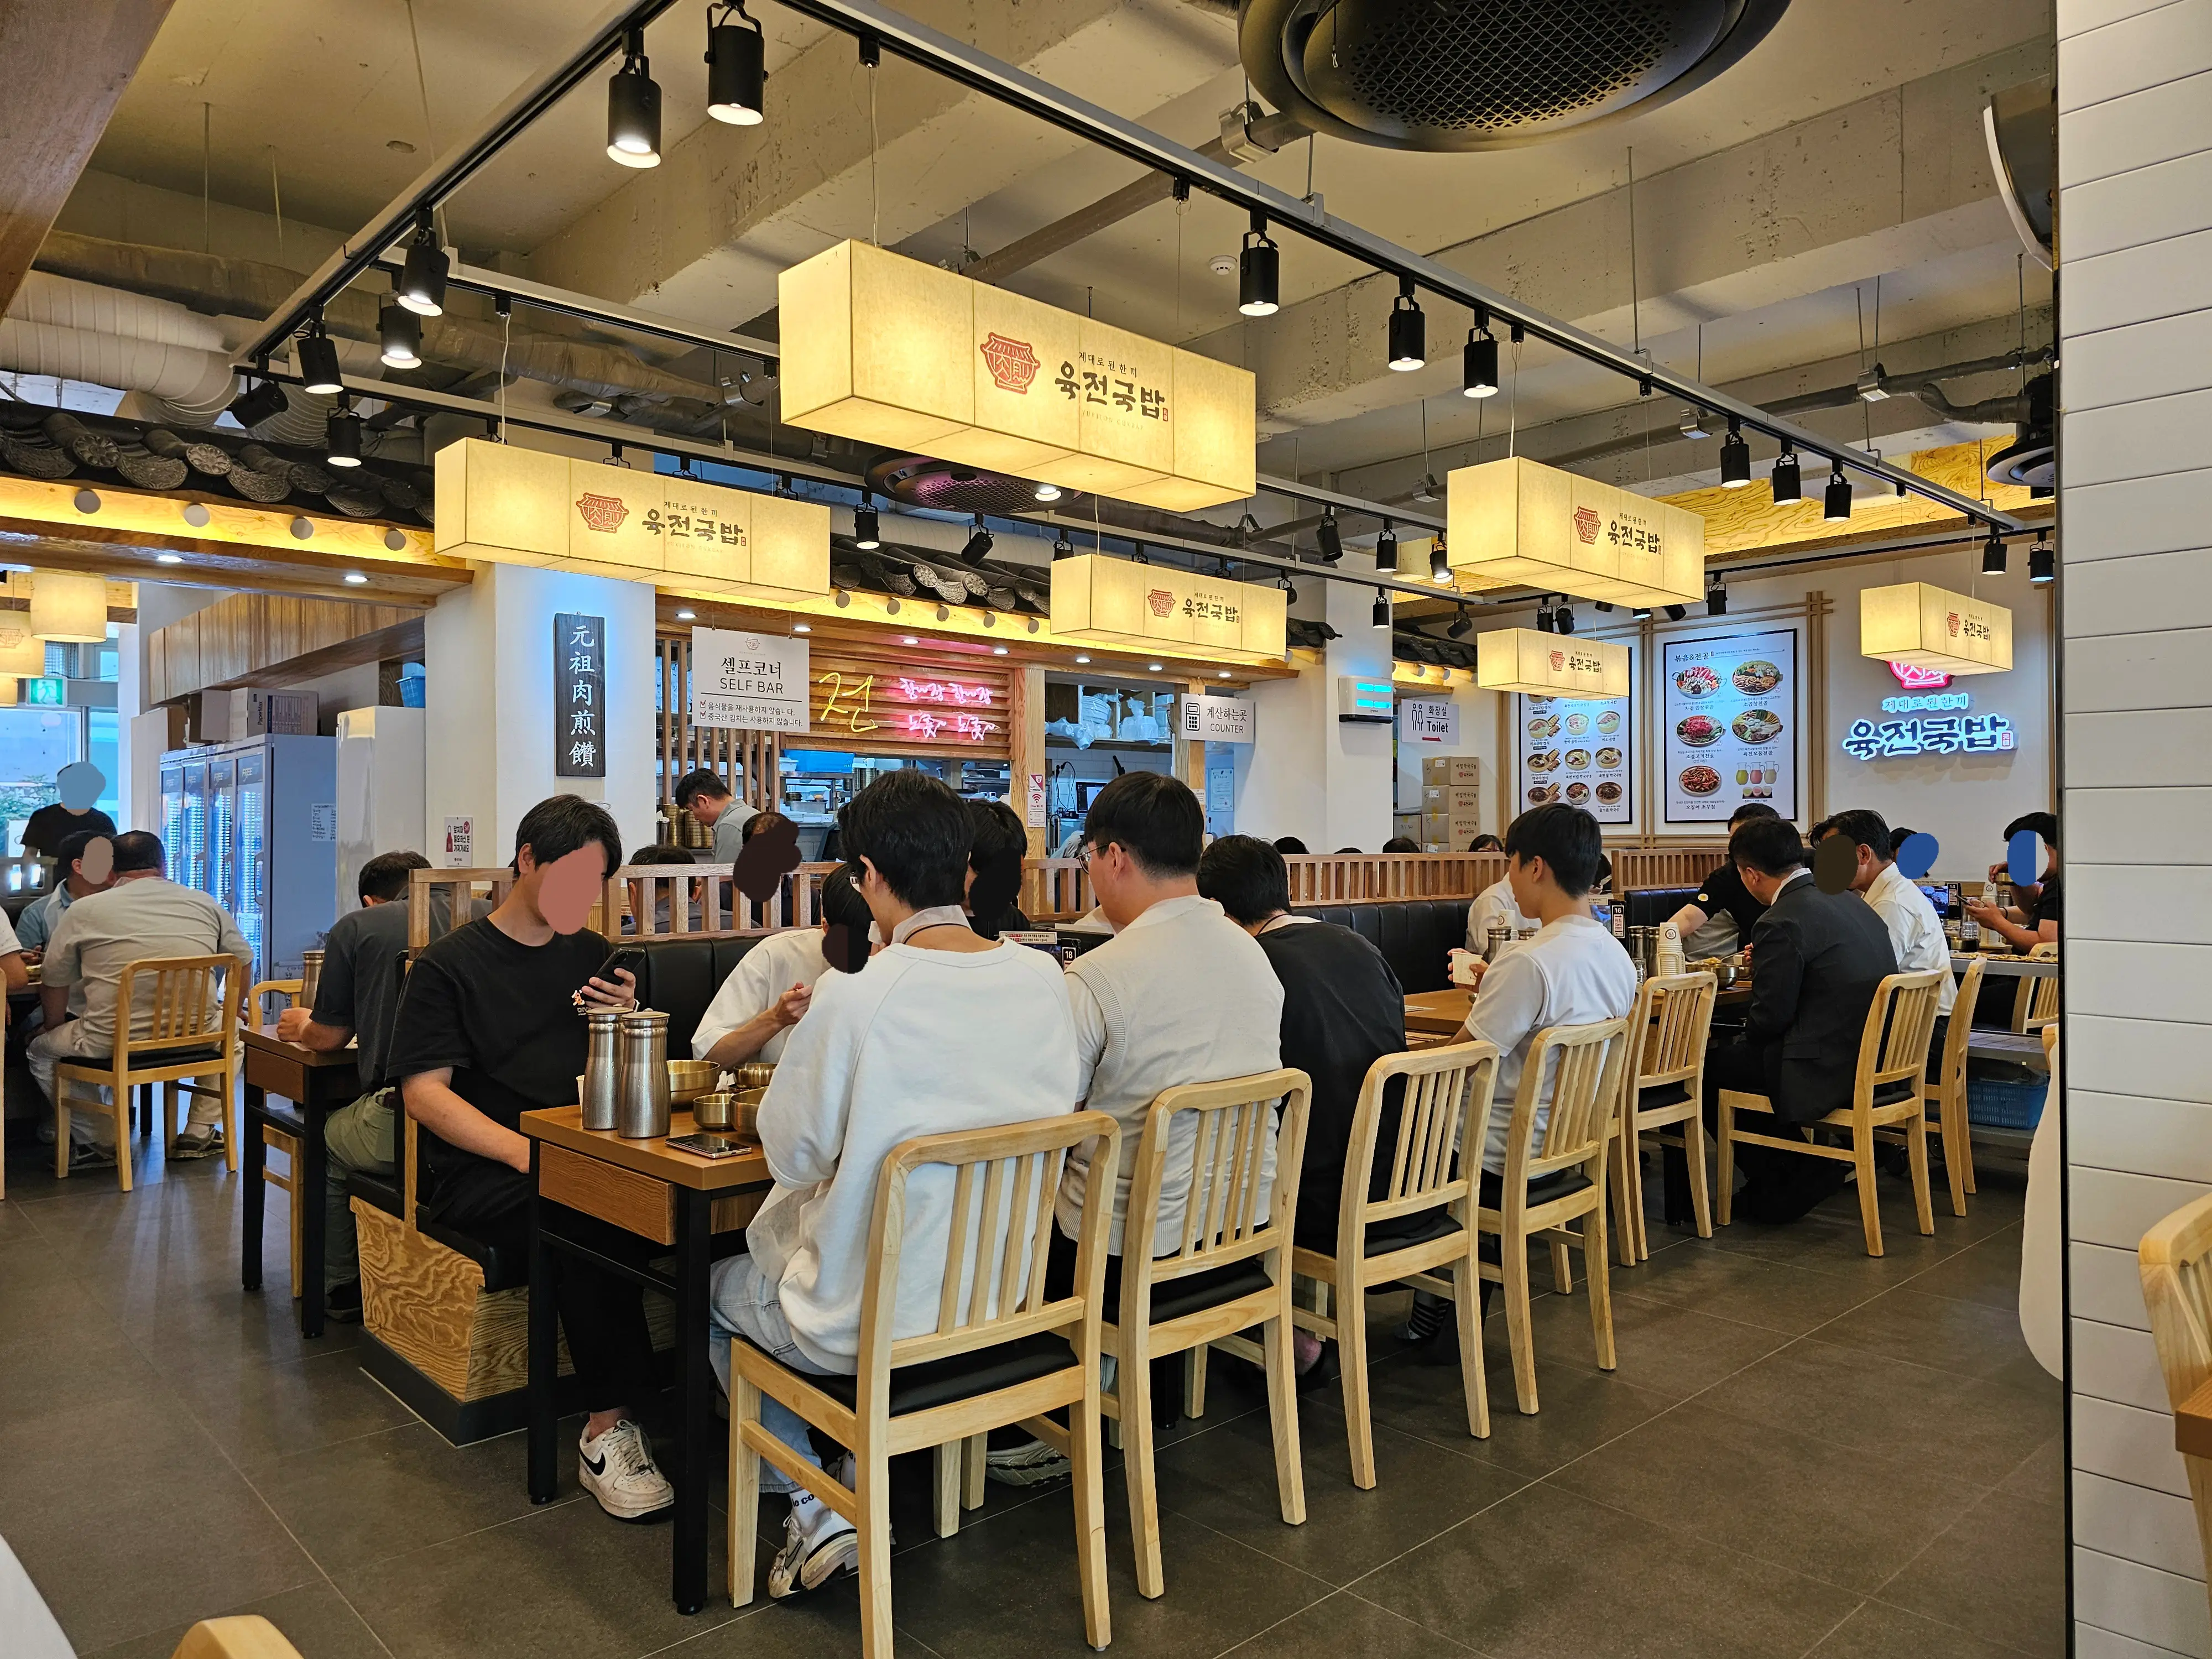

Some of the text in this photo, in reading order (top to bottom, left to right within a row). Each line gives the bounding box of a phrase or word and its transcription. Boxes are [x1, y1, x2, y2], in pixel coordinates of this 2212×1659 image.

[1055, 361, 1165, 419] 육전국밥
[642, 509, 743, 545] 육전국밥
[1608, 520, 1660, 554] 육전국밥
[1182, 598, 1238, 622] 육전국밥
[1963, 619, 1989, 640] 육전국밥
[1569, 656, 1601, 673] 육전국밥
[1674, 653, 1709, 662] 볶음&전골
[721, 656, 781, 680] 셀프코너
[720, 677, 783, 694] SELF BAR
[708, 702, 795, 716] 음식물을 재사용하지 않습니다.
[1207, 707, 1247, 722] 계산하는곳
[1429, 706, 1447, 716] 화장실
[708, 713, 803, 727] 중국산 김치는 사용하지 않습니다.
[1211, 723, 1244, 733] COUNTER
[1427, 721, 1448, 733] Toilet
[1845, 715, 2006, 757] 육전국밥
[1065, 951, 1073, 959] 18
[792, 1494, 815, 1507] le co
